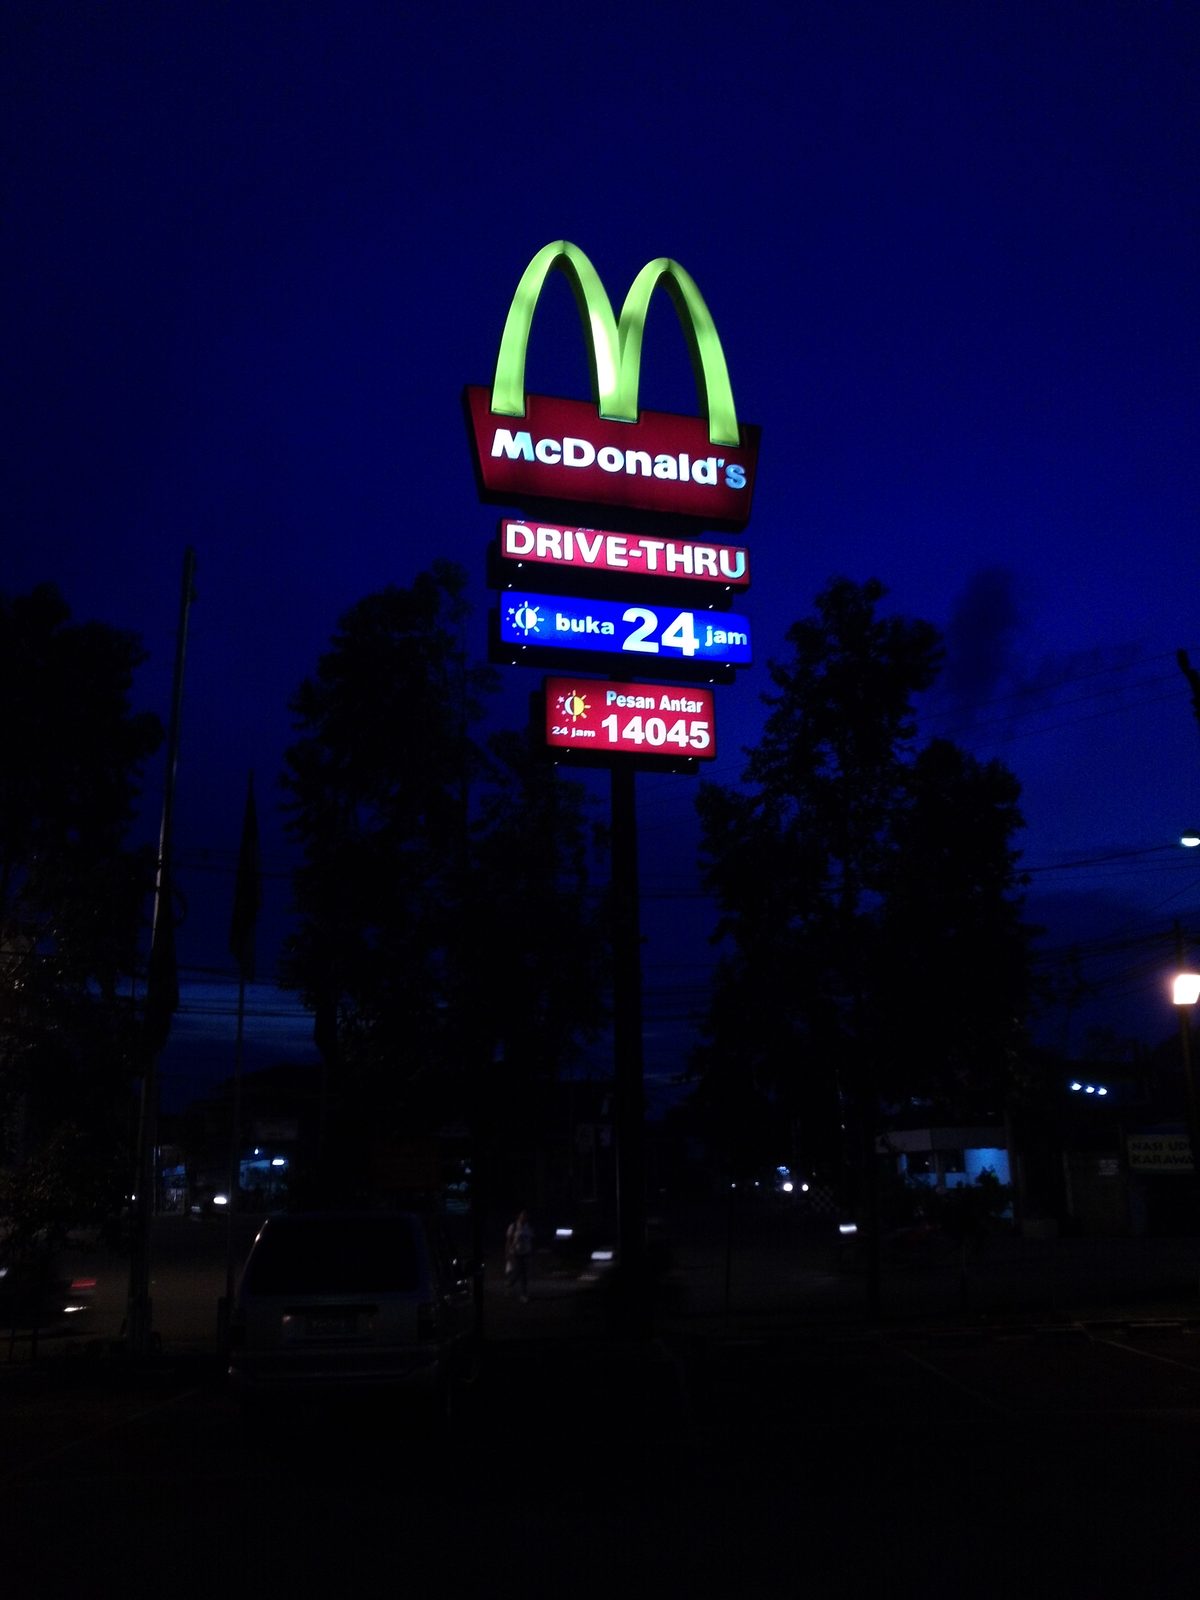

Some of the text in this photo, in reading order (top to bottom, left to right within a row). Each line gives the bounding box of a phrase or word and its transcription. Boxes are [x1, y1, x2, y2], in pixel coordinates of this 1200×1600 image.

[491, 428, 746, 489] McDonald's
[506, 523, 746, 578] DRIVE-THRU
[555, 607, 748, 656] buka 24 jam
[606, 690, 703, 713] Pesan Antar
[552, 726, 596, 738] 24 jam
[602, 714, 710, 749] 14045
